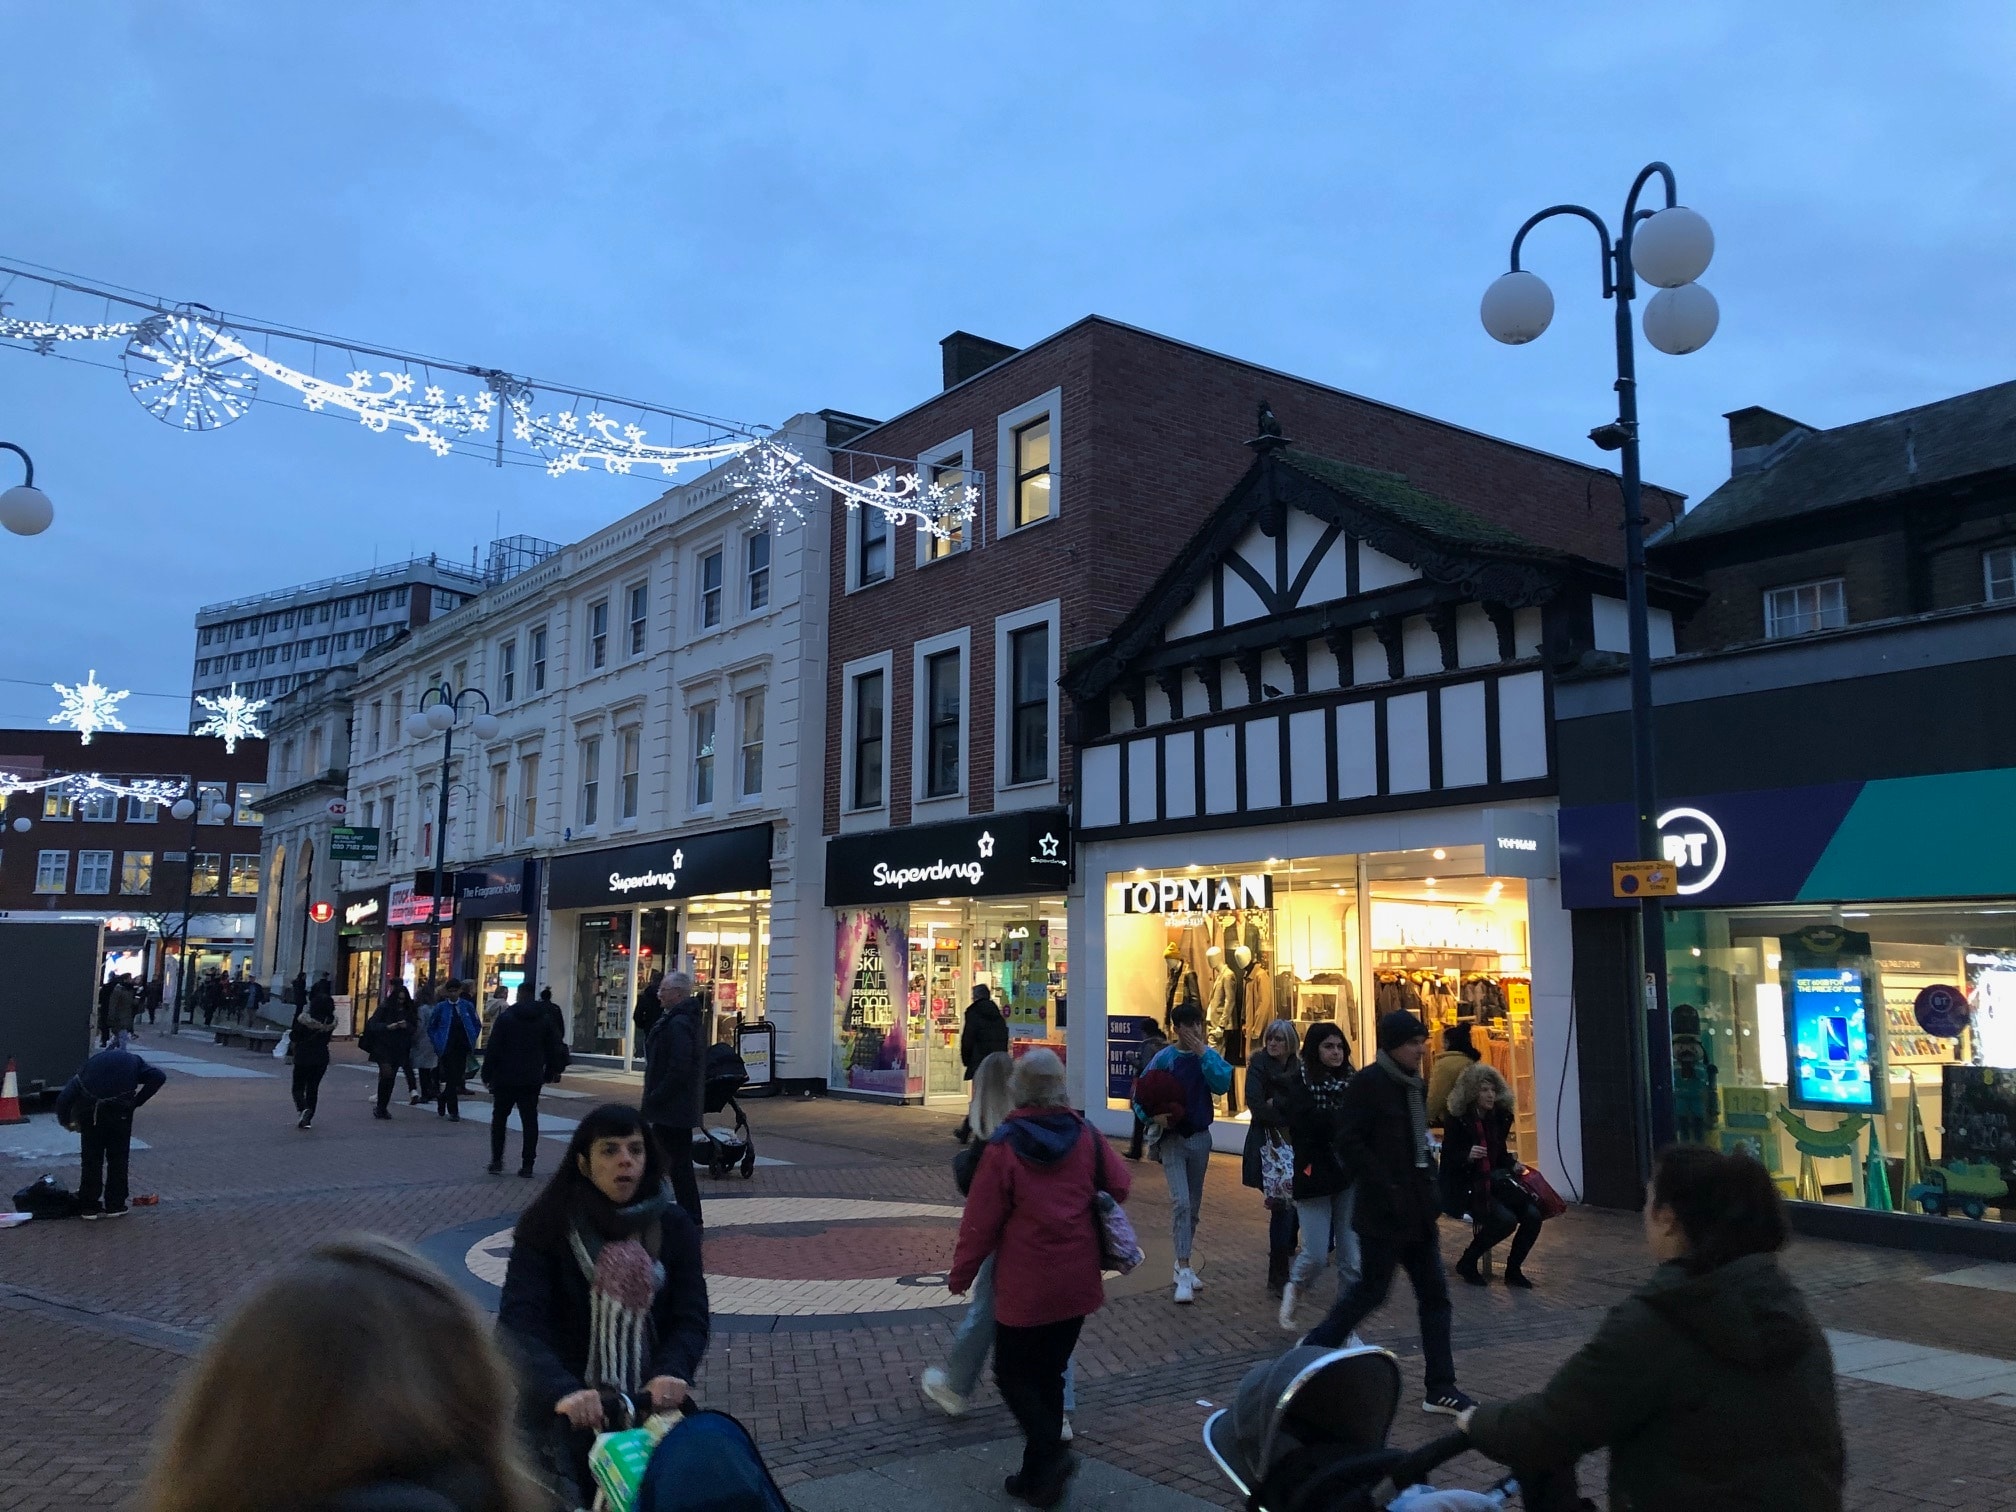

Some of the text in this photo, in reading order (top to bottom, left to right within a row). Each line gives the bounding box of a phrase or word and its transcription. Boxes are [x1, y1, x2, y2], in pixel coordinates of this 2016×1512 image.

[1497, 837, 1537, 850] TOPMAN
[1663, 833, 1708, 867] BT
[1030, 856, 1067, 866] Superdrug
[873, 859, 984, 889] Superdrug
[609, 870, 676, 893] Superdrug
[463, 883, 521, 898] The Fragrance Shop
[1112, 874, 1267, 914] TOPMAN
[851, 996, 889, 1009] FOOD
[1110, 1022, 1131, 1034] SHOES
[1110, 1050, 1123, 1062] BUY
[1110, 1063, 1126, 1076] HALF
